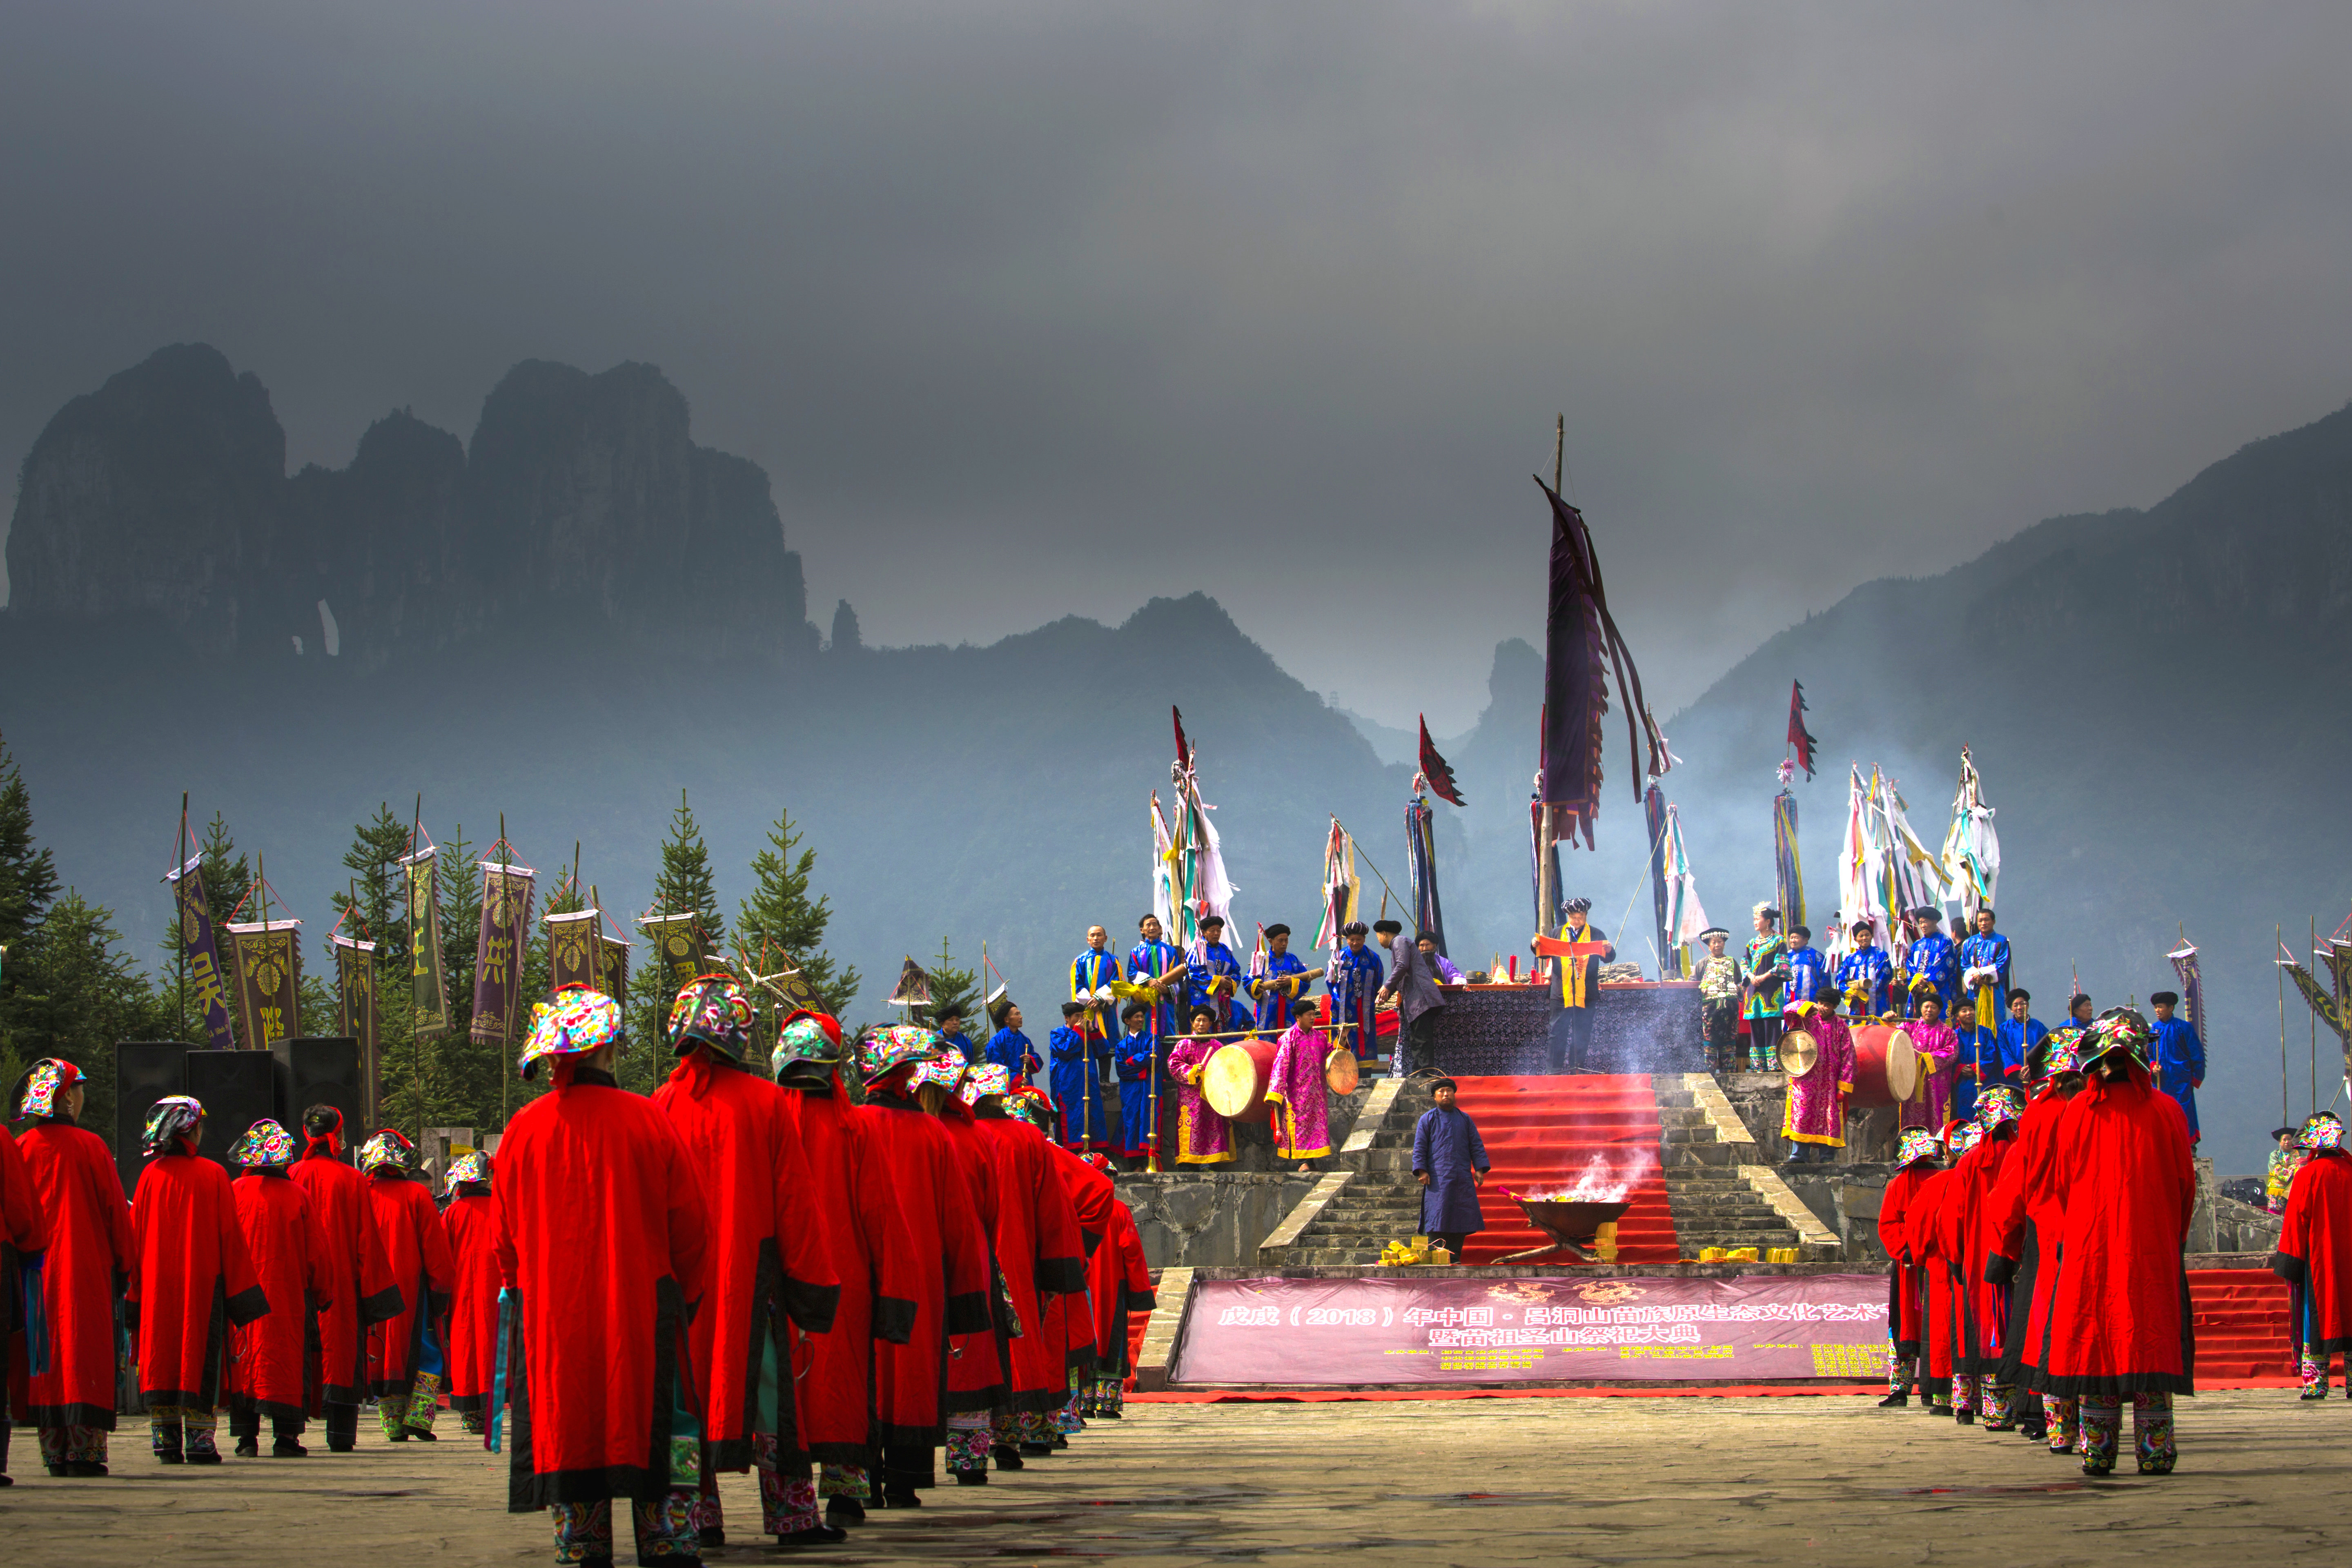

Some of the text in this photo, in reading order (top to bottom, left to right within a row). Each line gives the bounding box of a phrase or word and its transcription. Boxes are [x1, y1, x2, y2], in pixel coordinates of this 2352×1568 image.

[1428, 1323, 1701, 1347] 暨苗祖圣山祭祀大典
